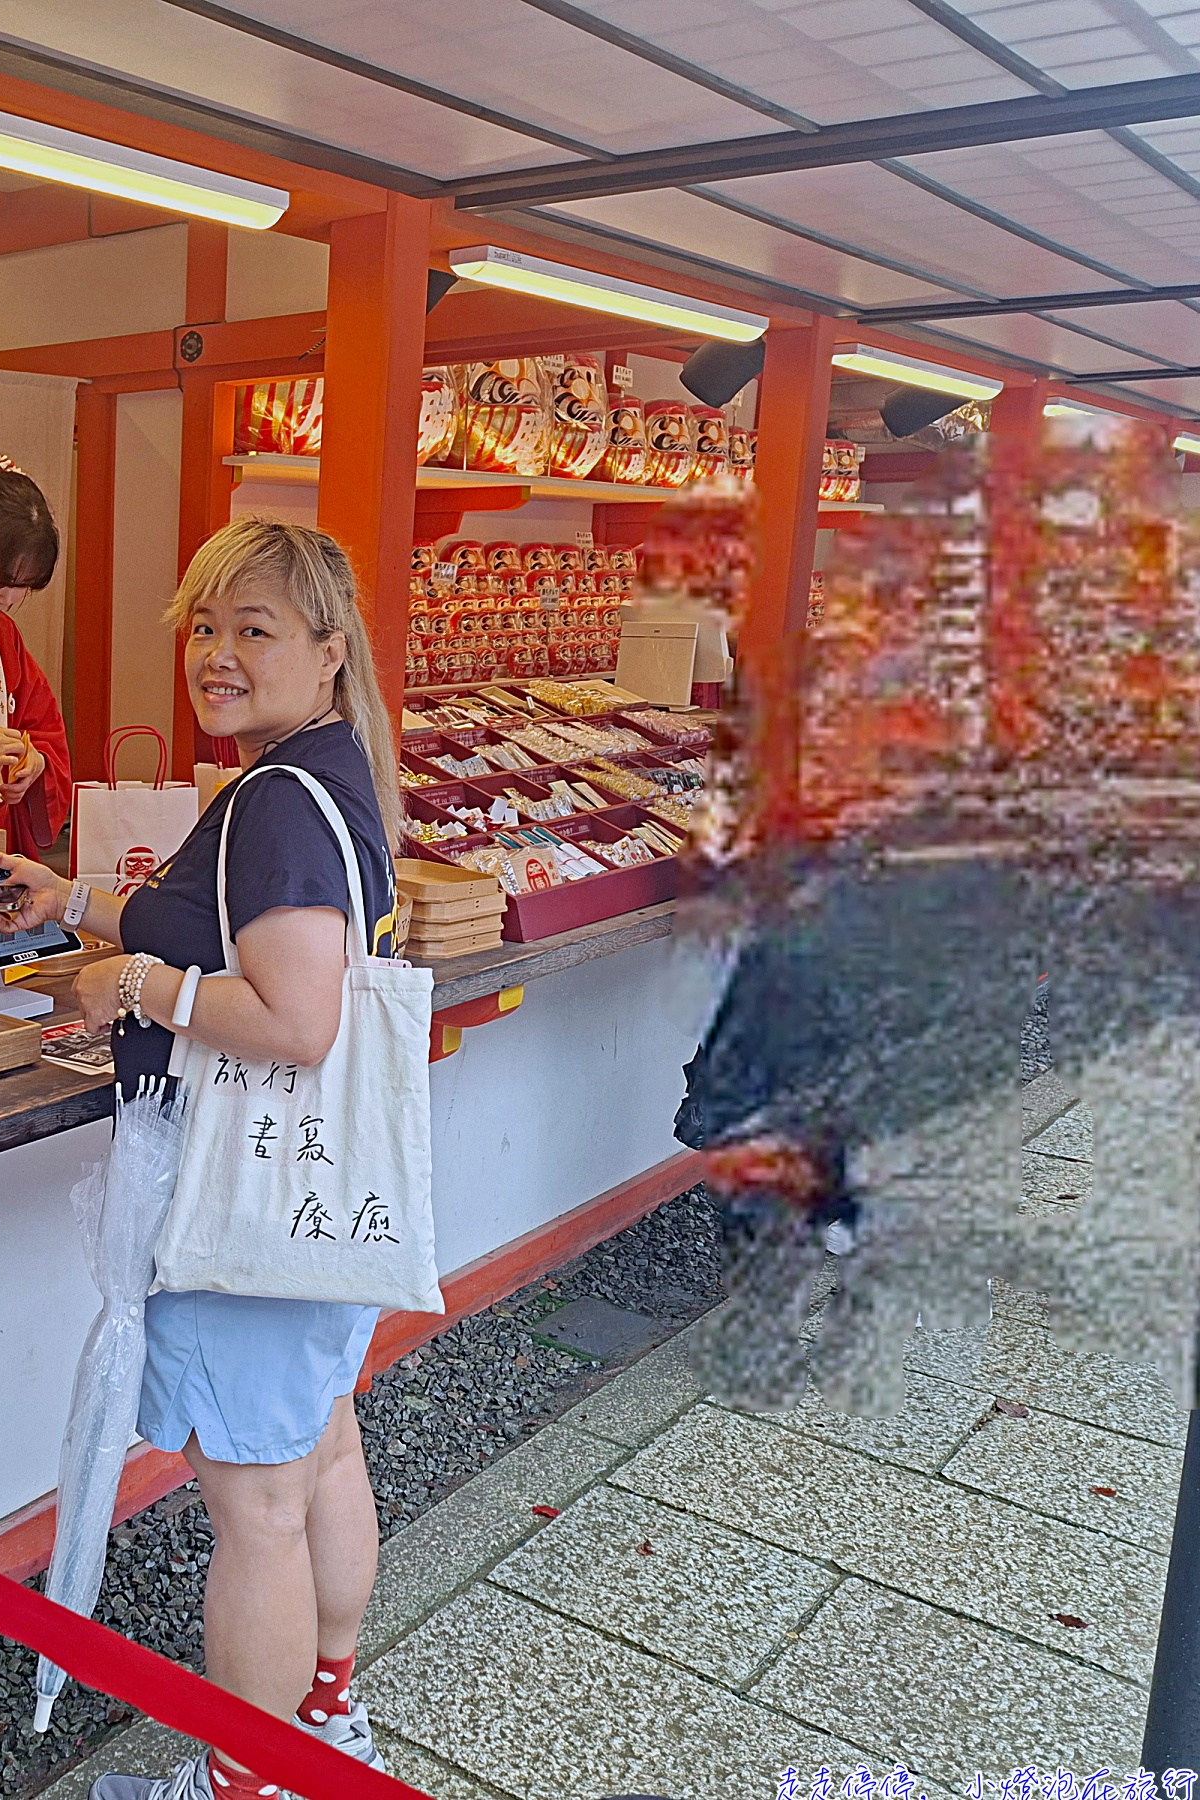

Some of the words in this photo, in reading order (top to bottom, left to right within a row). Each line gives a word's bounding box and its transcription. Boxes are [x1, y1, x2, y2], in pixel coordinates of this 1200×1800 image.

[213, 1052, 298, 1094] 旅行
[248, 1114, 335, 1166] 書寫
[291, 1191, 400, 1243] 療癒
